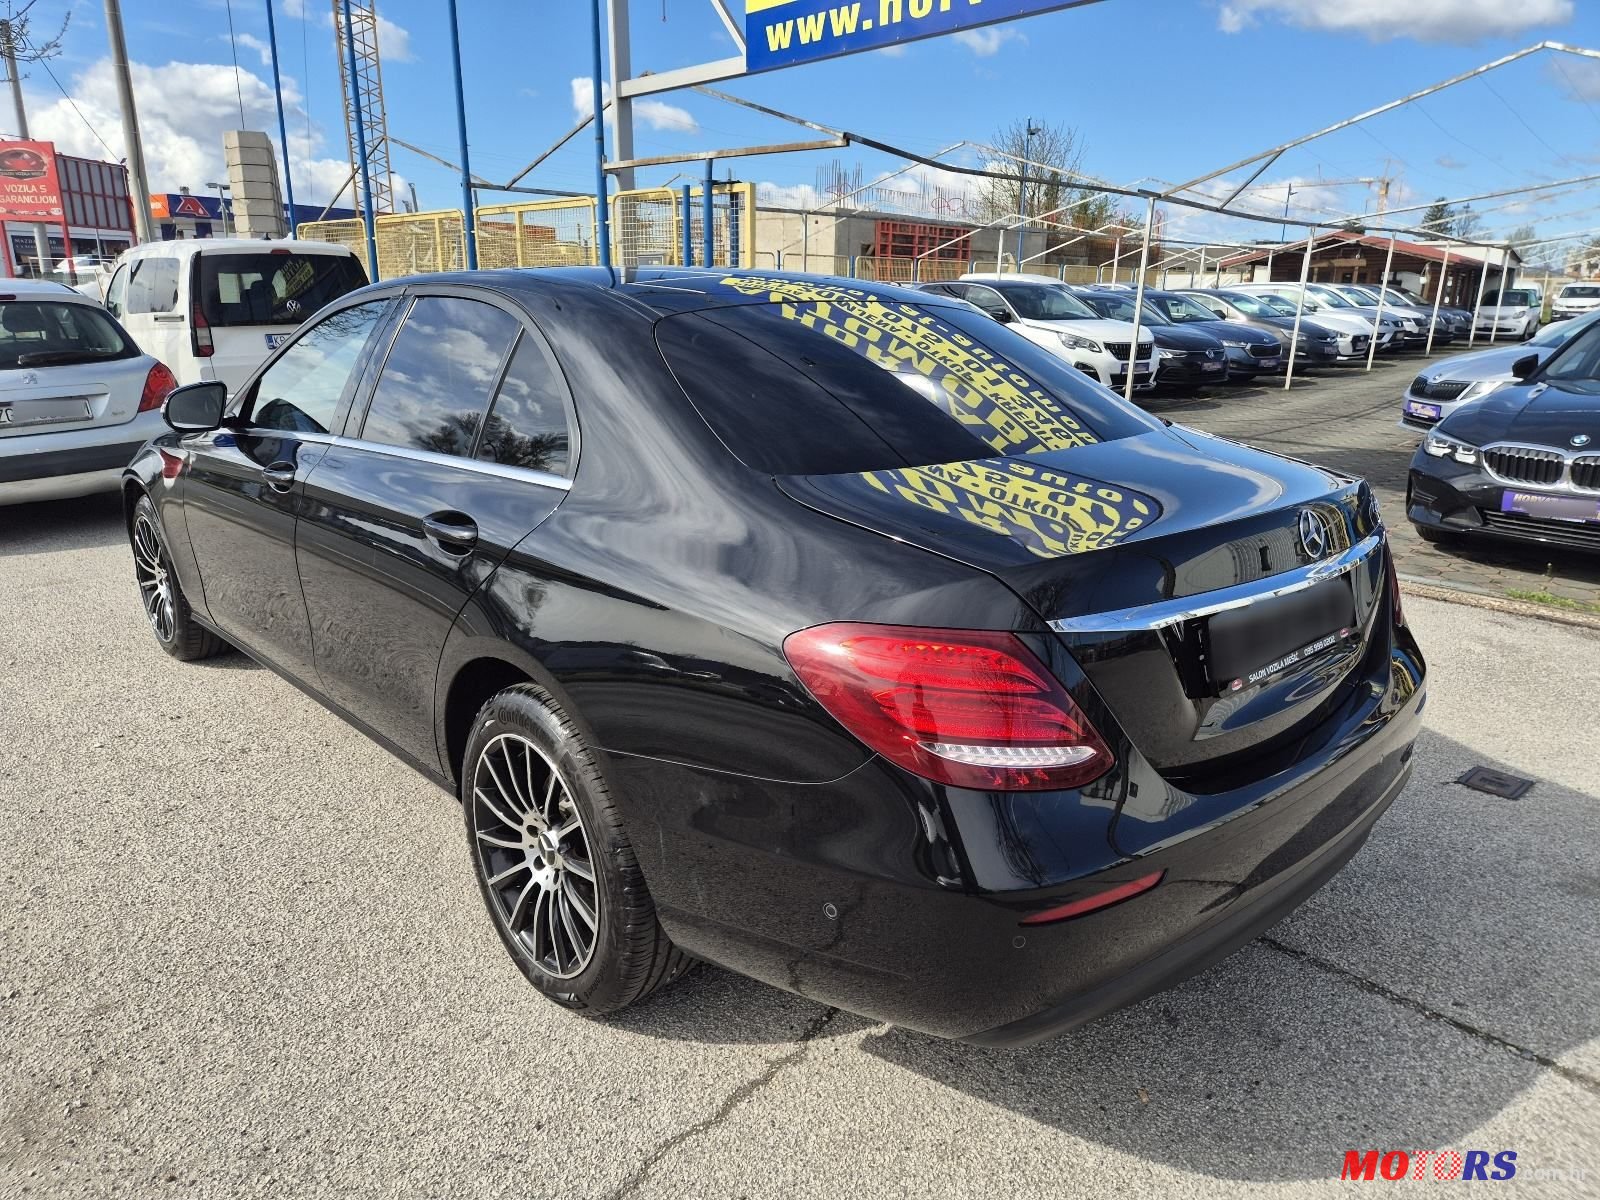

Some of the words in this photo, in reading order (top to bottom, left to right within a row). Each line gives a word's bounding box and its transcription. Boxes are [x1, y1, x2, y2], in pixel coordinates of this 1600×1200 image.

[4, 184, 38, 193] VOZILA
[40, 184, 48, 193] S
[1249, 667, 1267, 683] SALON
[1266, 660, 1285, 674] VOZILA
